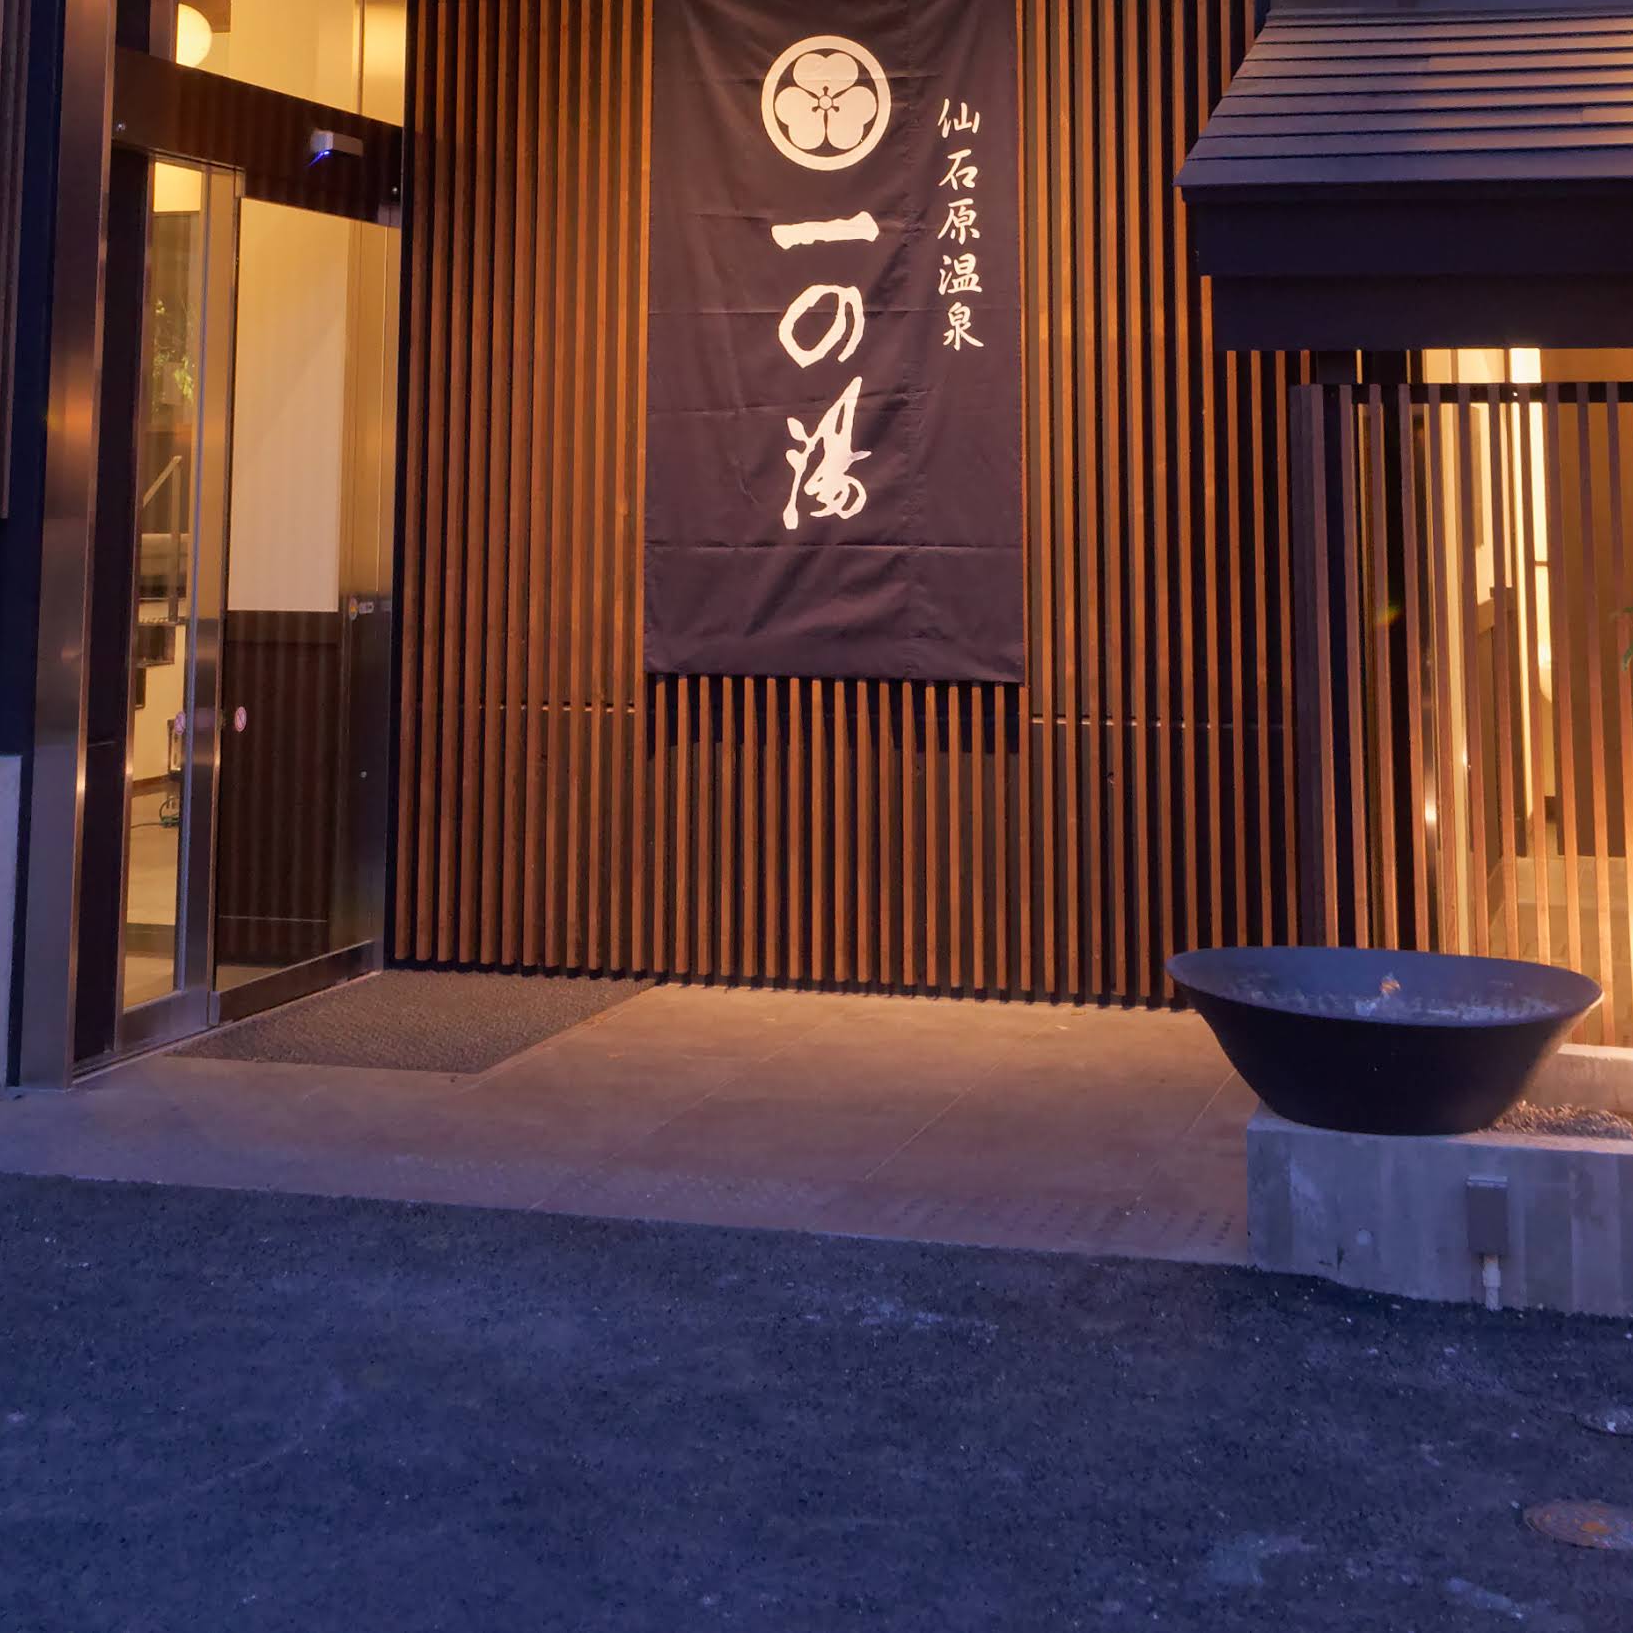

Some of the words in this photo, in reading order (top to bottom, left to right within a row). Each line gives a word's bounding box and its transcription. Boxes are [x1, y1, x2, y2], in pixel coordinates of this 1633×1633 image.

[936, 98, 985, 351] 仙石原温泉
[770, 209, 880, 531] 一の湯
